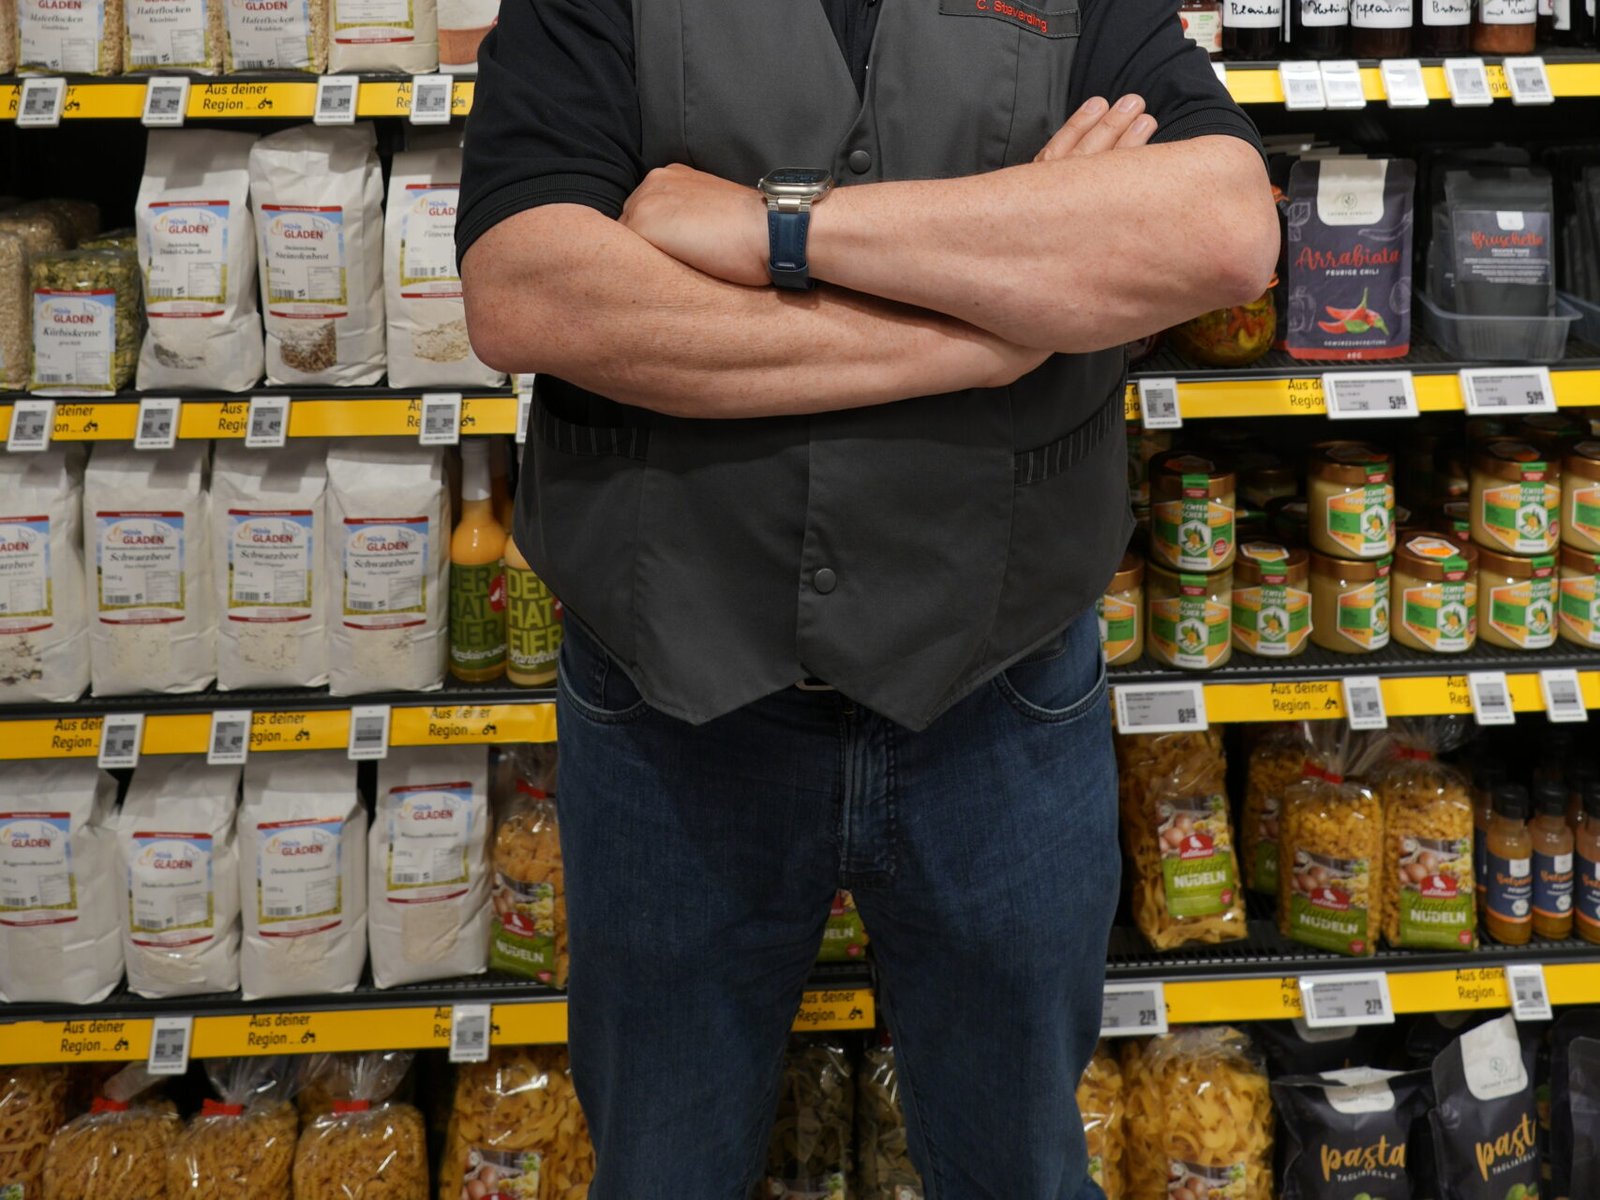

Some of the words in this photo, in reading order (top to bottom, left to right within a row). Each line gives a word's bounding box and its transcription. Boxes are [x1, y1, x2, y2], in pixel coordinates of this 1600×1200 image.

[38, 0, 82, 10] GLADEN
[136, 5, 192, 16] Haferflocken
[245, 1, 288, 11] GLADEN
[241, 15, 295, 25] Haferflocken
[994, 0, 1048, 33] Steverding
[204, 85, 228, 95] Aus
[231, 84, 268, 95] deiner
[397, 84, 411, 94] Au
[203, 98, 243, 111] Region
[428, 207, 455, 217] GLAD
[168, 224, 209, 235] GLADEN
[284, 229, 324, 240] GLADEN
[1295, 244, 1401, 271] Arrabiata
[53, 314, 94, 325] GLADEN
[42, 327, 101, 338] Kürbiskerne
[1287, 380, 1309, 391] Aus
[56, 405, 94, 417] deiner
[220, 403, 241, 414] Aus
[408, 401, 421, 411] Au
[218, 418, 247, 432] Regi
[123, 535, 164, 545] GLADEN
[252, 534, 293, 544] GLADEN
[0, 542, 29, 552] ADEN
[367, 541, 409, 552] GLADEN
[109, 551, 172, 563] Schwarzbrot
[239, 550, 299, 562] Schwarzbrot
[353, 558, 415, 569] Schwarzbrot
[510, 599, 553, 629] HAT
[510, 625, 562, 657] EIER
[1447, 677, 1468, 688] Aus
[1271, 683, 1293, 695] Aus
[1296, 683, 1328, 695] deiner
[1273, 699, 1311, 712] Region
[1449, 693, 1470, 707] Reg
[252, 714, 267, 725] us
[269, 713, 306, 725] deiner
[430, 707, 452, 719] Aus
[55, 719, 77, 731] Aus
[80, 719, 103, 731] dei
[428, 724, 468, 738] Region
[250, 730, 281, 744] egion
[52, 736, 92, 751] Region
[413, 810, 454, 821] GLADEN
[11, 838, 52, 848] GLADEN
[281, 844, 323, 856] GLADEN
[153, 859, 193, 869] GLADEN
[1173, 870, 1226, 888] NUDELN
[1410, 910, 1467, 923] NUDELN
[1300, 914, 1358, 934] NUDELN
[496, 940, 545, 963] NUDELN
[1456, 969, 1476, 981] Aus
[1479, 969, 1505, 980] deine
[802, 992, 817, 1003] us
[820, 990, 856, 1002] deiner
[1458, 986, 1495, 1001] Region
[1283, 995, 1301, 1010] Reg
[434, 1007, 452, 1019] Au
[797, 1009, 836, 1023] Region
[249, 1015, 271, 1027] Aus
[274, 1013, 310, 1026] deiner
[63, 1021, 85, 1034] Aus
[89, 1020, 125, 1033] deiner
[433, 1025, 451, 1039] Reg
[60, 1039, 100, 1053] Region
[247, 1033, 287, 1048] Region
[1320, 1135, 1406, 1182] pasta
[1336, 1170, 1397, 1183] TAGLIATELLE
